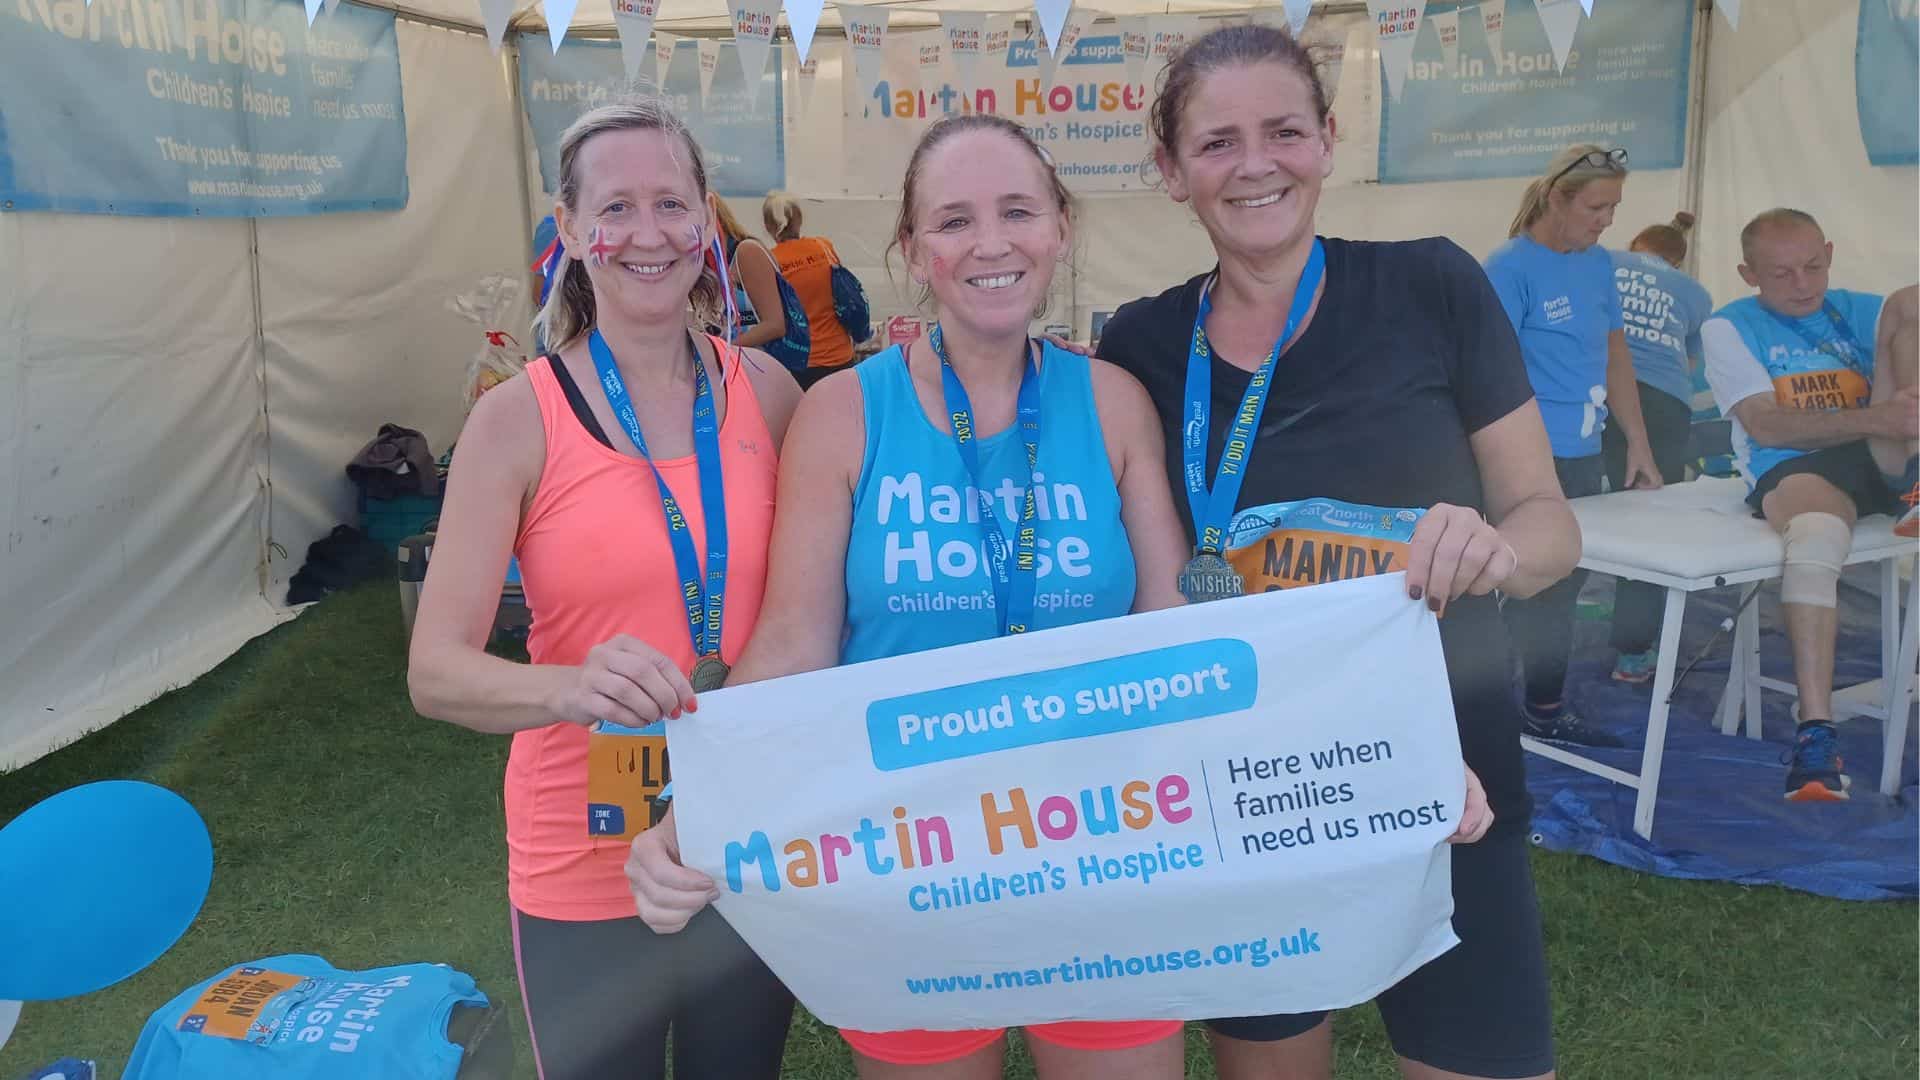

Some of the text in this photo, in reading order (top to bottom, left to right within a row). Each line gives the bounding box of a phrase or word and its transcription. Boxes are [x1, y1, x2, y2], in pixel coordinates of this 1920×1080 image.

[616, 2, 653, 16] House
[737, 9, 771, 25] Martin
[1378, 7, 1417, 23] Martin
[738, 22, 769, 36] House
[850, 20, 881, 35] Martin
[950, 27, 979, 40] Martin
[1380, 22, 1415, 35] House
[184, 0, 287, 77] Hose
[852, 33, 881, 46] House
[952, 39, 978, 50] House
[1498, 51, 1580, 77] Houe
[146, 67, 291, 120] Children's Hspice
[1066, 121, 1143, 143] Hospice
[1791, 373, 1840, 394] MARK
[951, 410, 973, 443] 2022
[1233, 427, 1249, 438] IT
[1226, 440, 1246, 461] DID
[877, 472, 1088, 525] Martin
[663, 497, 687, 531] 2022
[1335, 505, 1375, 521] north
[1352, 521, 1375, 532] run
[884, 529, 1093, 585] Hose
[1262, 537, 1394, 585] MANDY
[1178, 575, 1243, 594] FINISHER
[887, 588, 1095, 613] Children's spice
[707, 609, 721, 630] DID
[707, 631, 720, 644] IT
[896, 662, 1231, 745] Proud to support
[1227, 739, 1393, 784] Here when
[1233, 780, 1355, 820] families
[595, 809, 611, 818] ZONE
[599, 818, 607, 832] A
[724, 806, 955, 894] Martin
[979, 774, 1193, 856] House
[1241, 799, 1449, 856] need us most
[908, 842, 1204, 913] Children's Hospice
[905, 927, 1322, 995] www.martinhouse.org.uk
[297, 982, 377, 1043] House
[329, 975, 412, 1053] Martin
